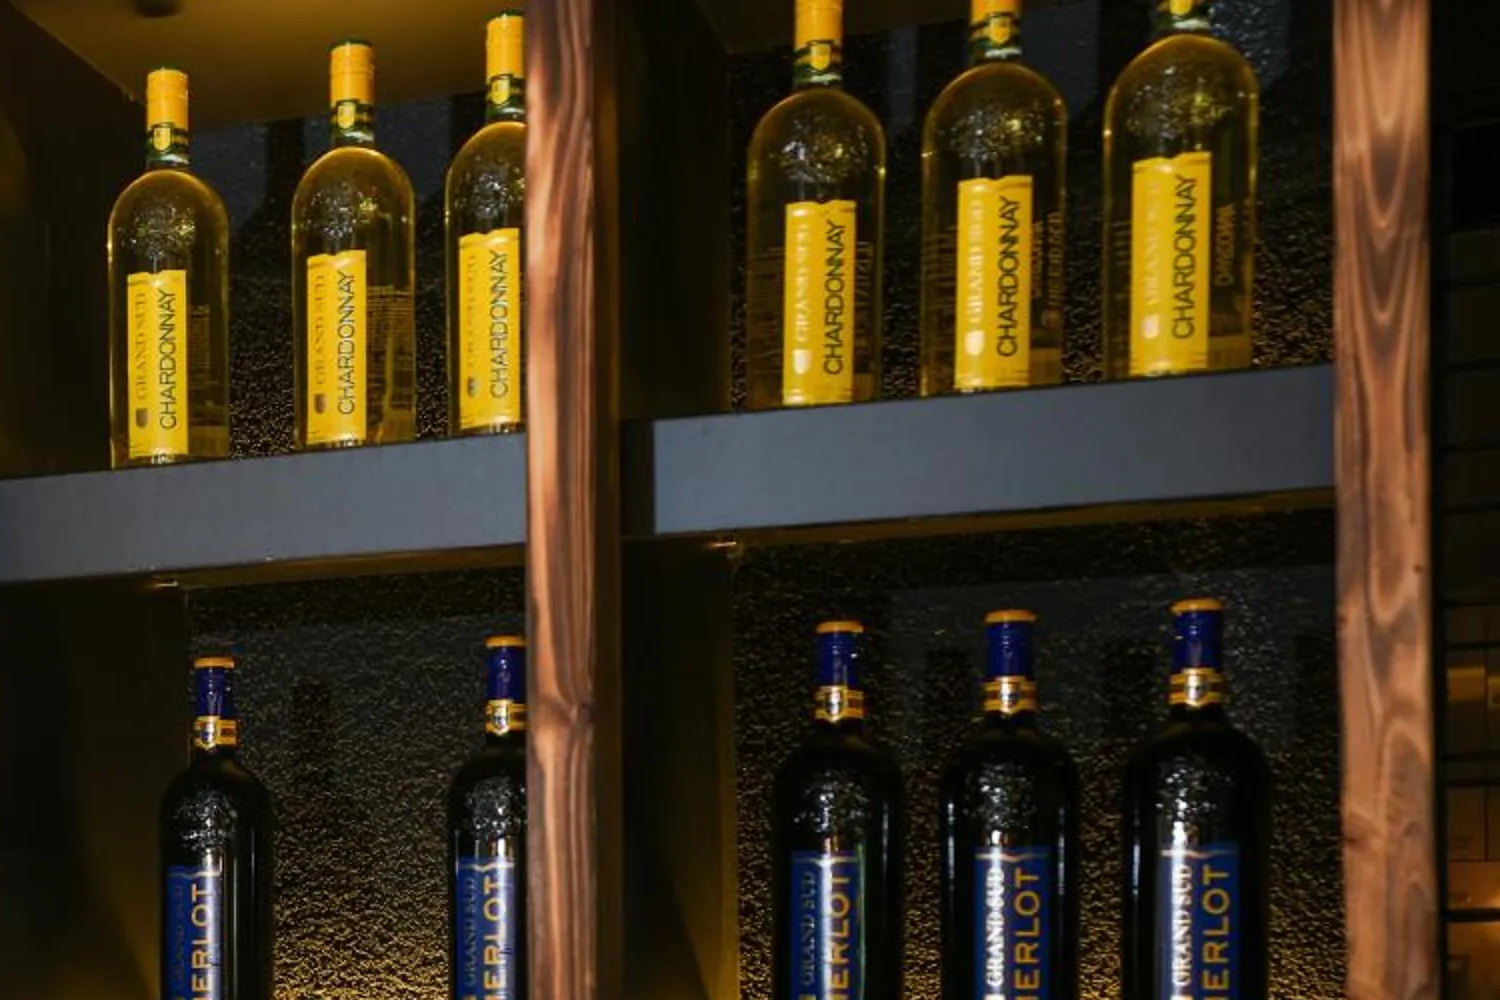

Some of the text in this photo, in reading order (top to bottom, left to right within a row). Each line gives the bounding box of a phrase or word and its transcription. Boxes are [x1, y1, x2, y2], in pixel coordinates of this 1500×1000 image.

[489, 250, 509, 398] CHARDONNAY
[823, 220, 845, 375] CHARDONNAY
[996, 196, 1020, 357] CHARDONNAY
[1172, 175, 1197, 339] CHARDONNAY
[157, 289, 178, 430] CHARDONNAY
[337, 271, 356, 416] CHARDONNAY
[985, 867, 1004, 987] GRAND SUD
[1172, 865, 1193, 987] GRAND SUD
